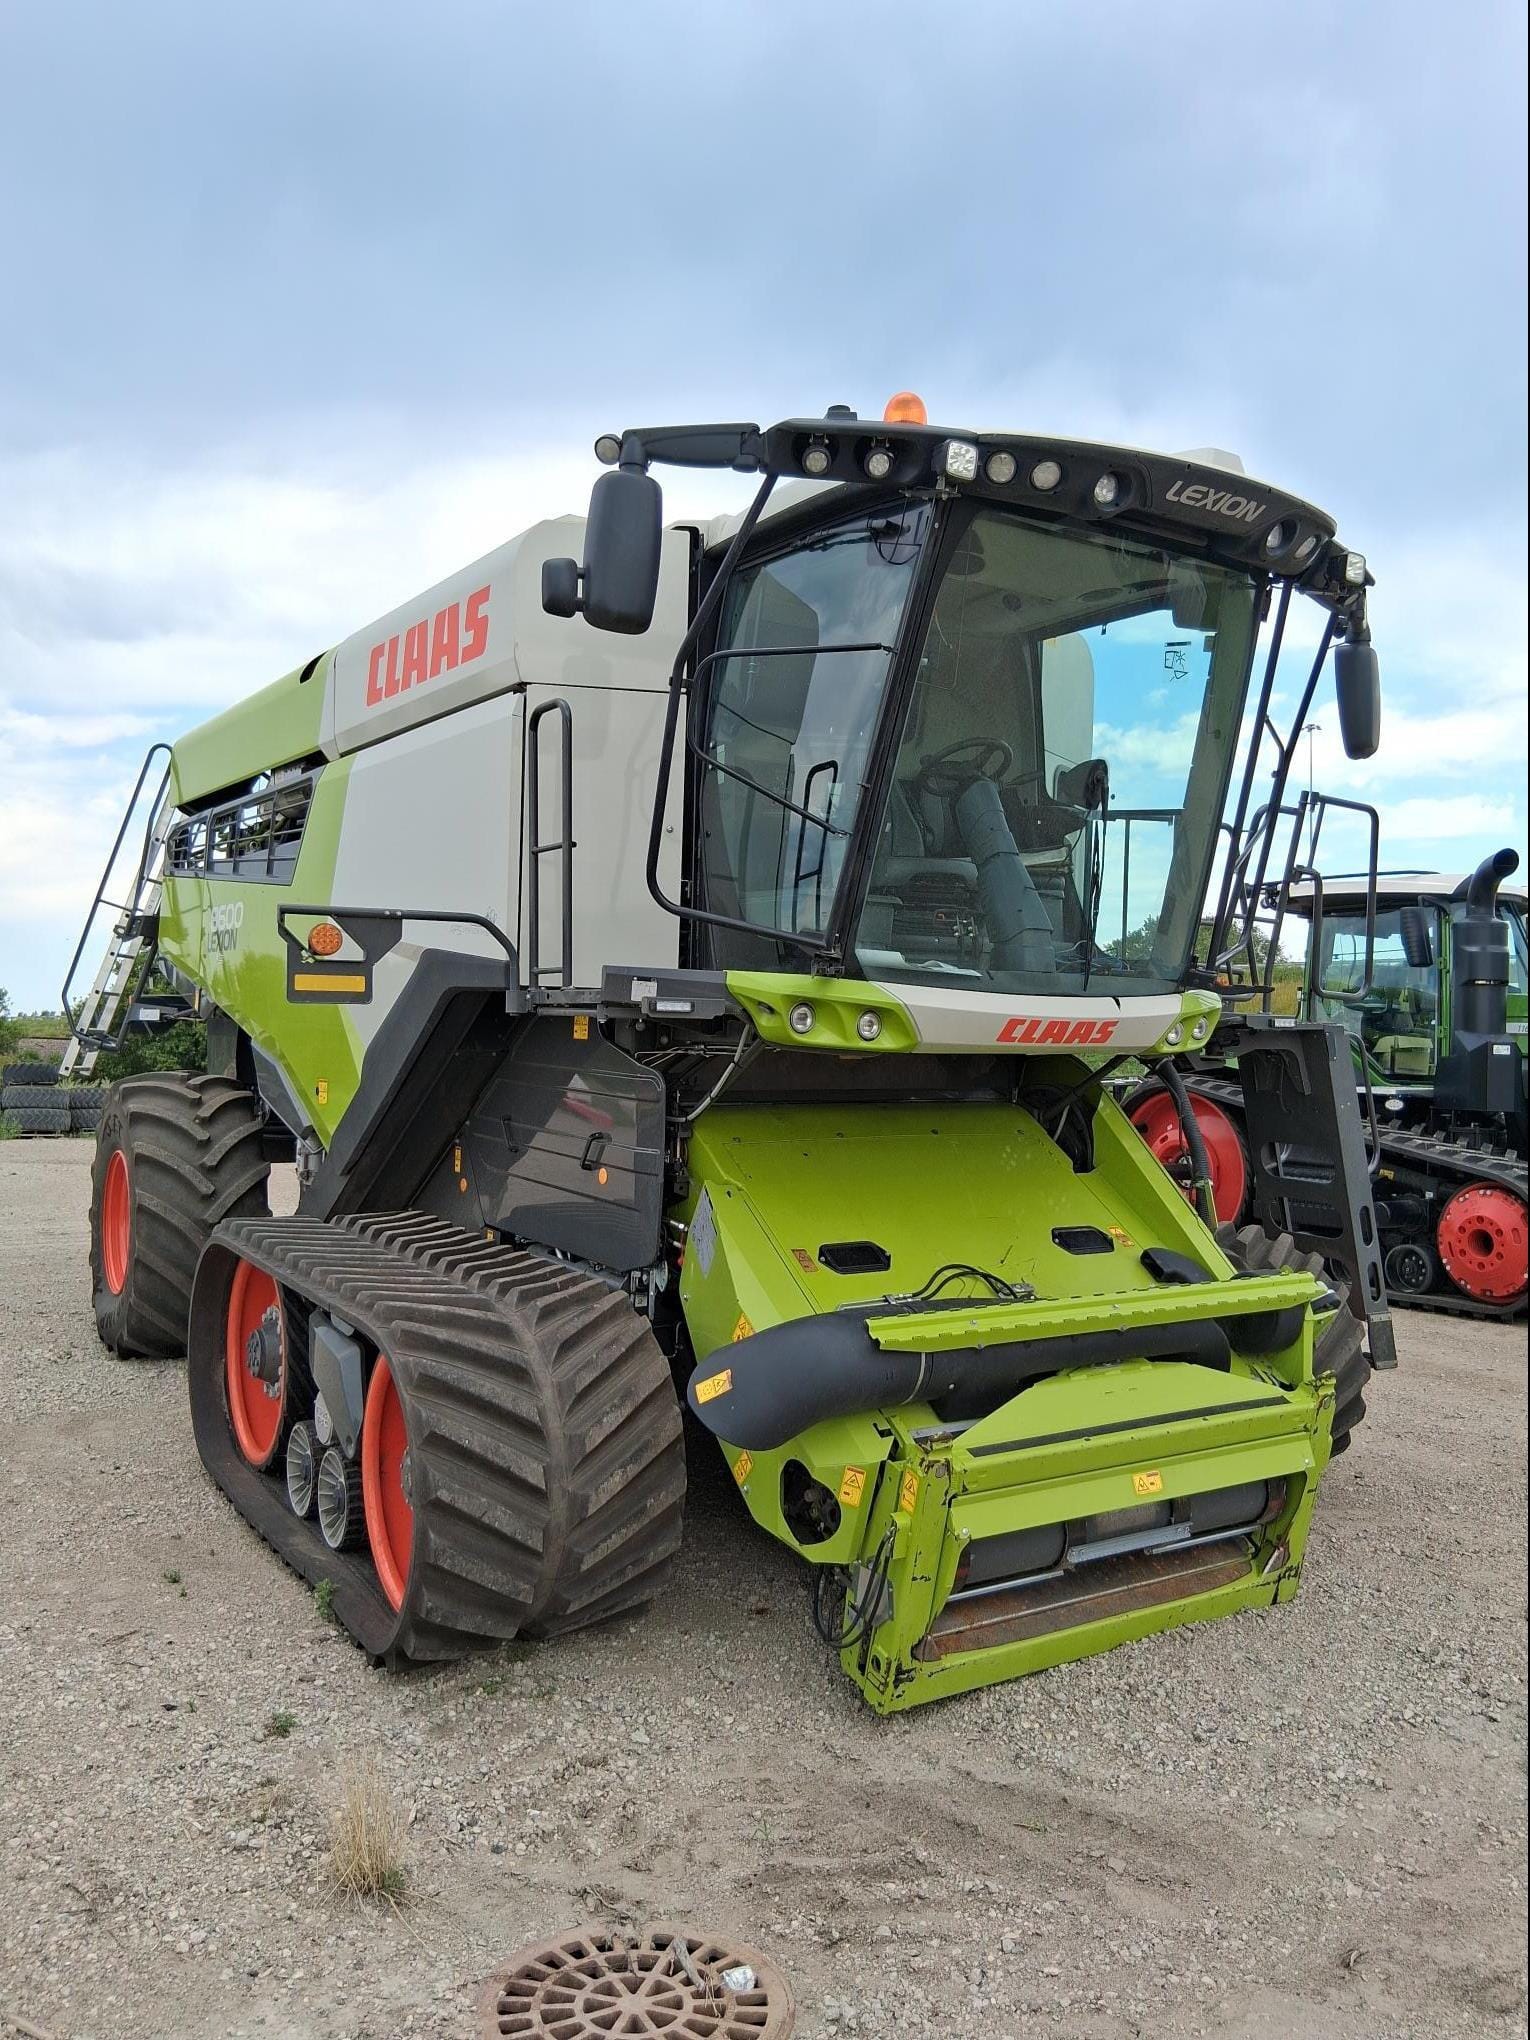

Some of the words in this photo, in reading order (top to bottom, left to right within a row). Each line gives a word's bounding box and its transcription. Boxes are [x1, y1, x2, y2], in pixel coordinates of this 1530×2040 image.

[1165, 480, 1267, 522] LEXION
[366, 584, 491, 707] CLAAS
[207, 928, 238, 952] LEXION
[996, 1018, 1120, 1044] CLAAS
